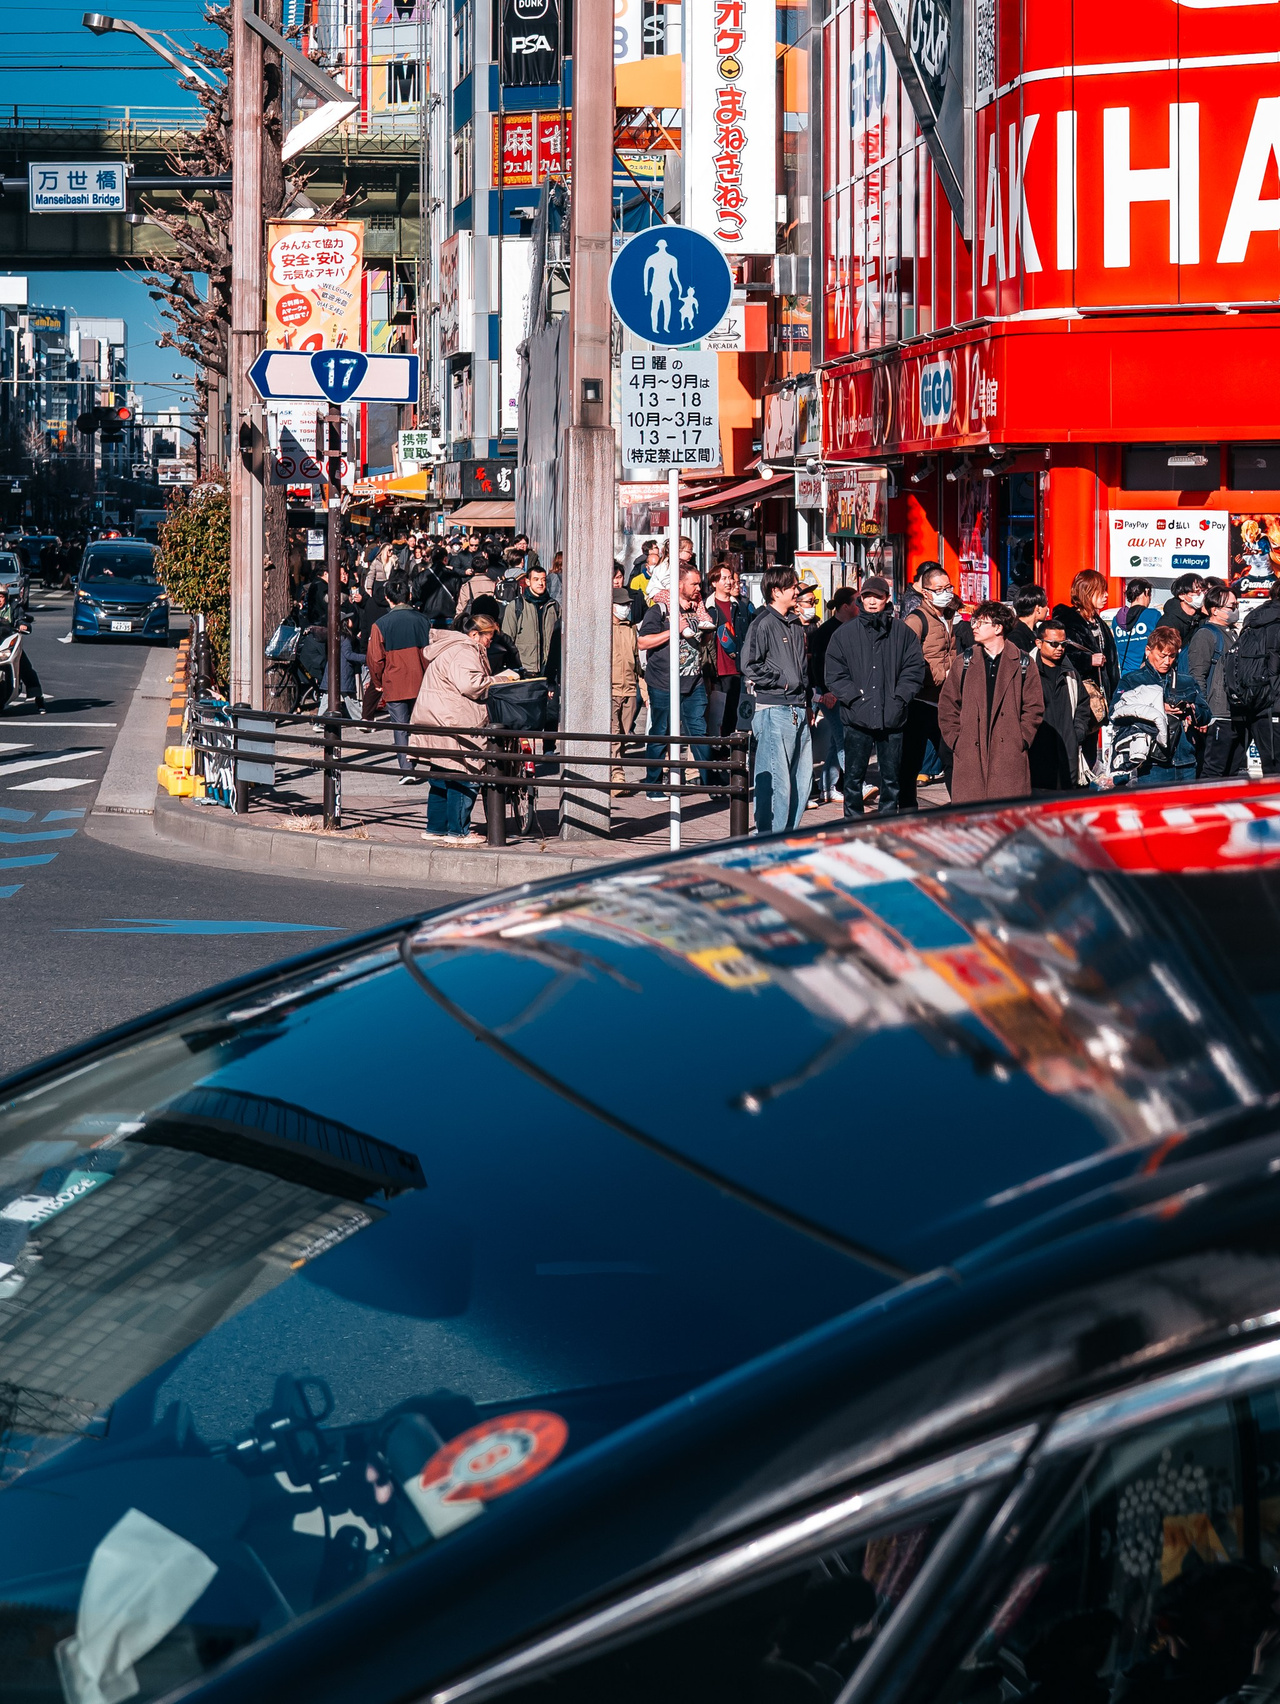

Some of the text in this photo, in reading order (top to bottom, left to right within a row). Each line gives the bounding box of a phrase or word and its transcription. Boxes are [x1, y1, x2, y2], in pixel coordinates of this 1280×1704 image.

[503, 126, 570, 156] 麻雀
[714, 84, 747, 242] まねきねこ
[38, 170, 116, 190] 万世橋
[35, 194, 120, 206] Manseibashi Bridge
[280, 239, 343, 251] みんなで協力
[282, 251, 344, 267] 安全・安心
[283, 267, 345, 280] 元気なアキバ
[322, 283, 353, 299] WELCOME
[631, 356, 683, 370] 日曜の
[323, 358, 358, 389] 17
[921, 368, 952, 418] GiGO
[971, 352, 998, 421] 2号館
[402, 433, 428, 445] 携帯
[402, 448, 429, 460] 買取
[1125, 520, 1149, 530] PayPay
[1168, 519, 1190, 530] d払い
[1211, 520, 1226, 531] Pay
[1127, 537, 1166, 547] au PAY
[1185, 538, 1205, 548] Pay
